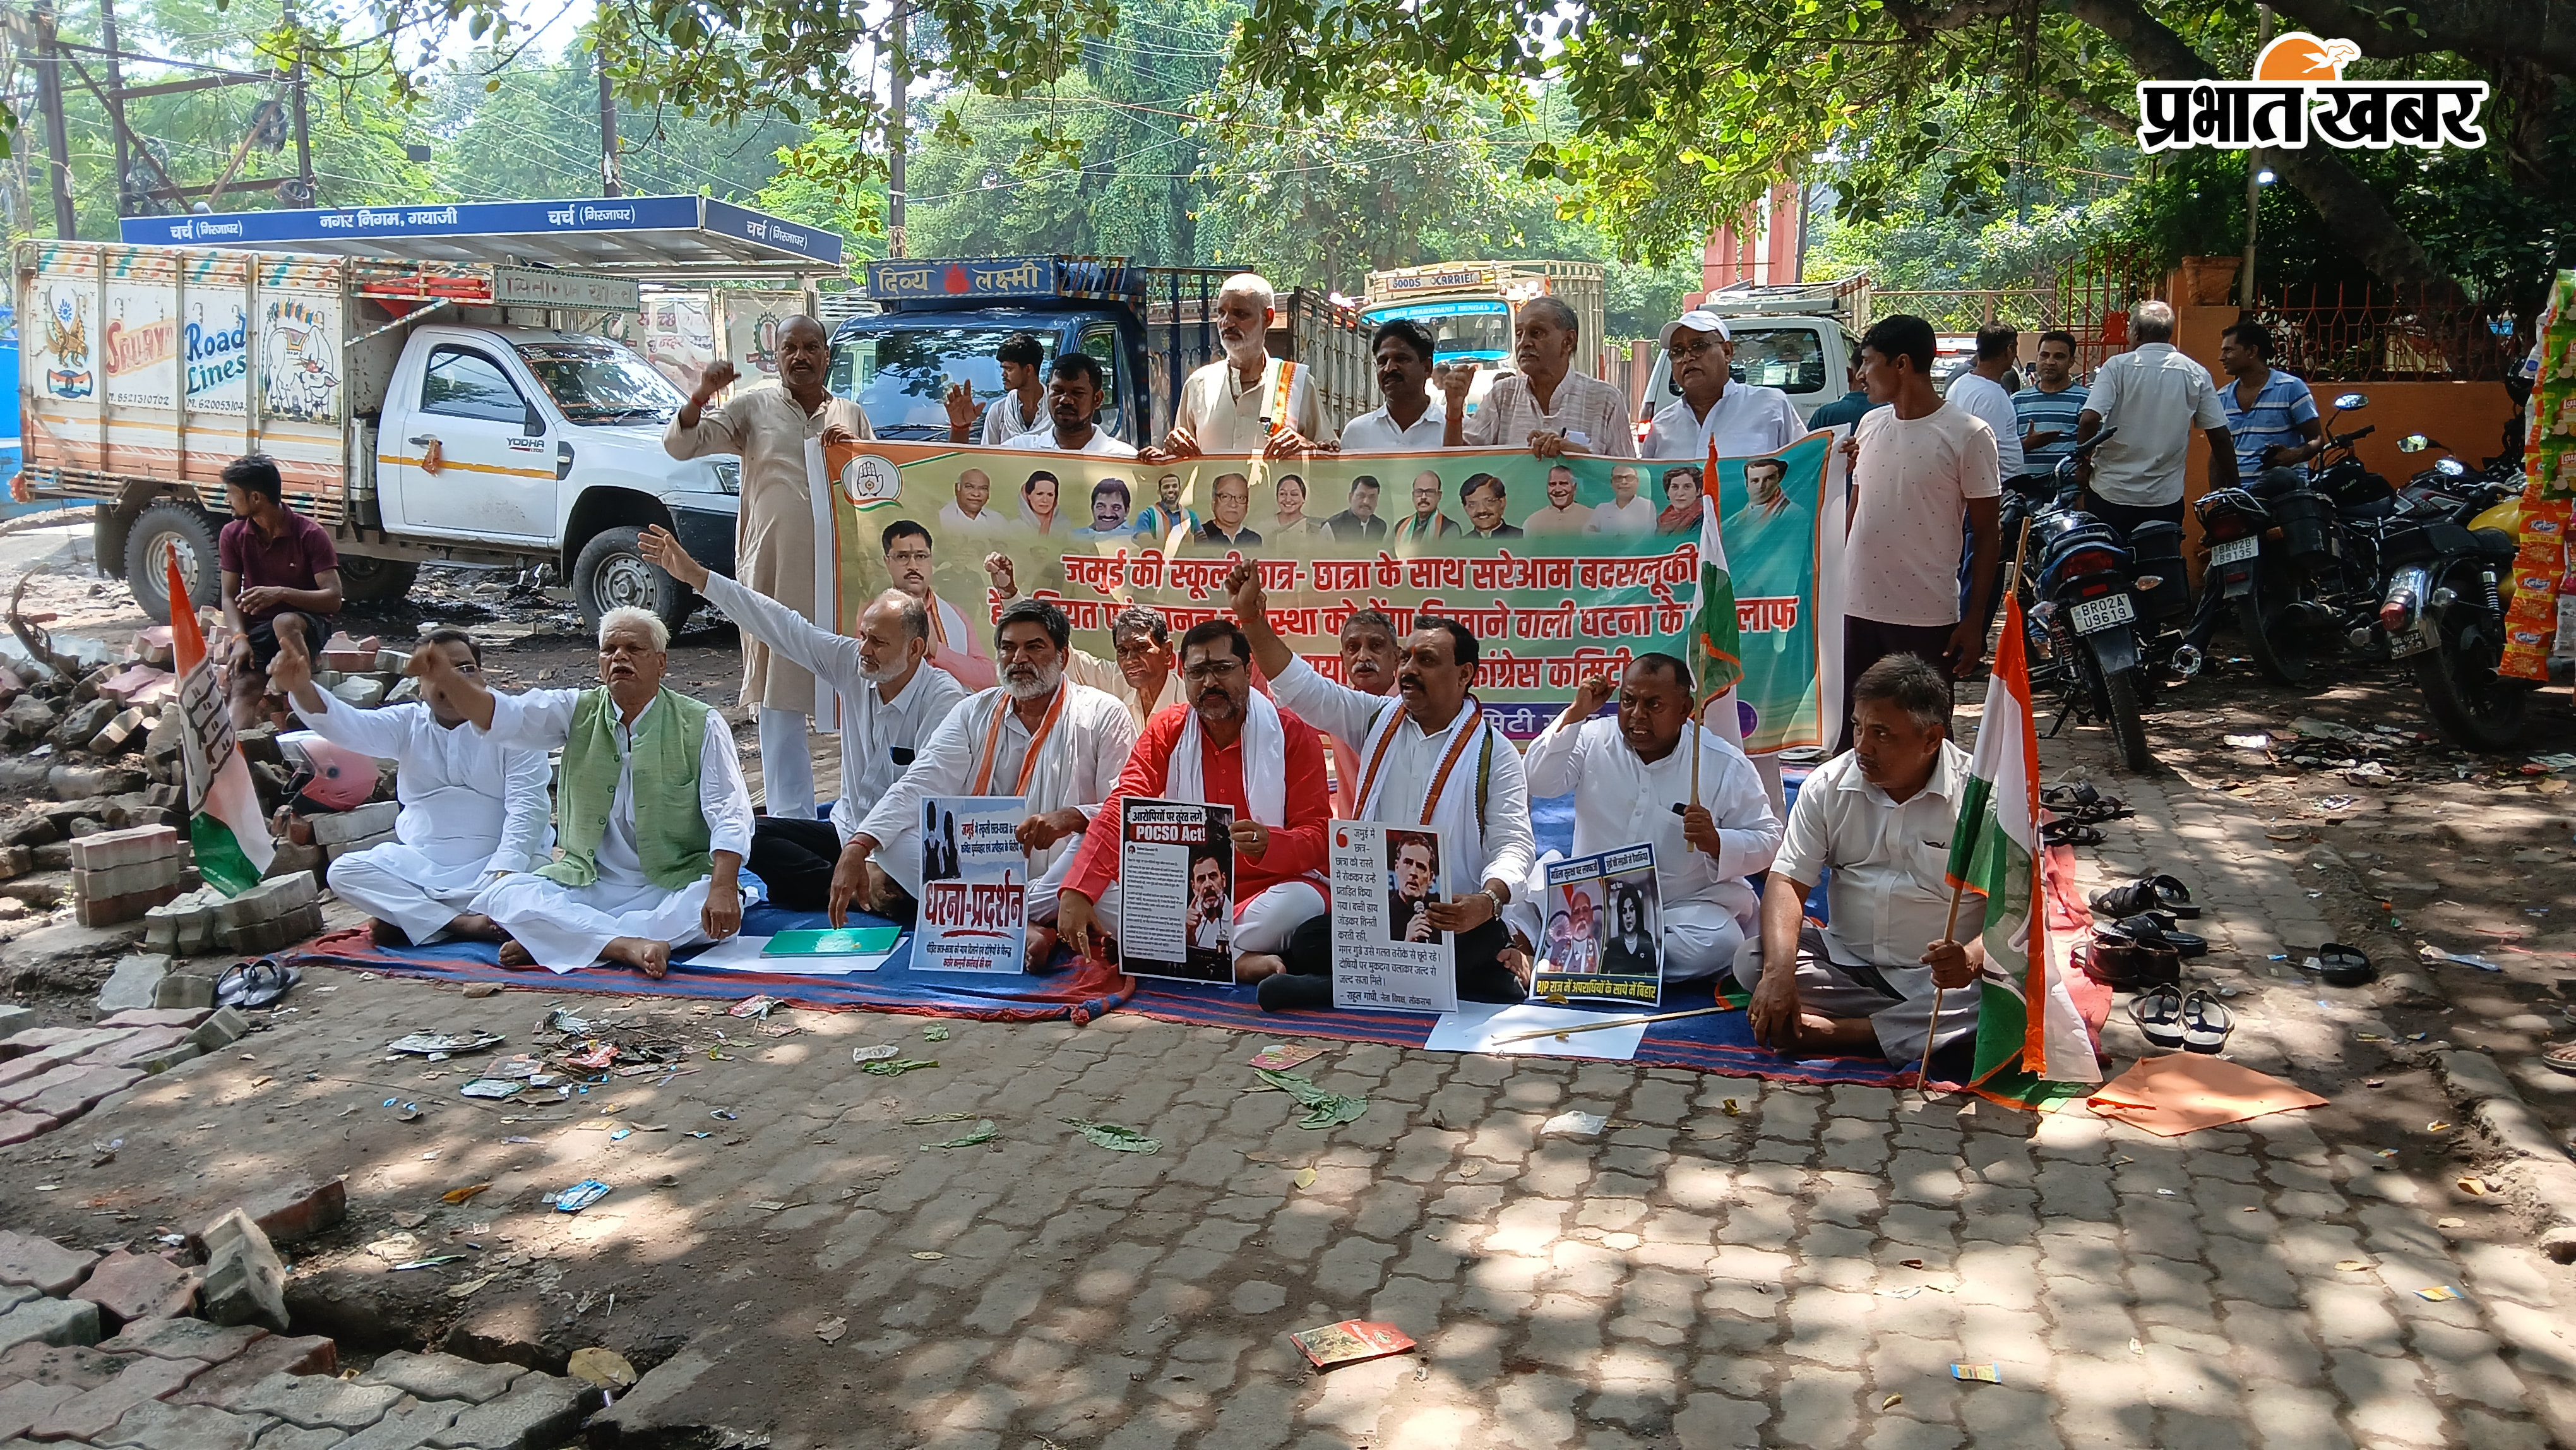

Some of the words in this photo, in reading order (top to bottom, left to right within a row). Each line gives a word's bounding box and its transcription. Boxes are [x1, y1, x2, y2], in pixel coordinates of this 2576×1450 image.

[320, 214, 353, 229] नगर
[357, 210, 405, 227] निगम,
[408, 207, 458, 224] गयाजी
[547, 204, 575, 225] चर्च
[580, 205, 635, 225] (गिरजाघर)
[170, 220, 193, 239] चर्च
[197, 224, 242, 239] (गिरजाघर)
[747, 219, 767, 239] चर्च
[769, 224, 808, 250] (गिरजाघर)
[876, 267, 936, 295] दिव्य
[972, 261, 1044, 291] लक्ष्मी
[1393, 278, 1421, 288] GOODS
[185, 312, 246, 360] Road
[186, 355, 246, 395] Lines
[506, 437, 545, 448] YODHA
[1061, 549, 1126, 594] जमुई
[1131, 549, 1165, 587] की
[1312, 561, 1370, 590] छात्रा
[1377, 551, 1402, 588] के
[1410, 558, 1466, 588] साथ
[1473, 549, 1576, 589] सरेआम
[1580, 544, 1698, 596] बदसलूकी
[2082, 596, 2125, 616] BR02A
[1516, 600, 1576, 638] वाली
[1580, 605, 1651, 637] घटना
[1657, 596, 1686, 633] के
[2084, 608, 2126, 628] U9619
[1132, 809, 1165, 822] आरोपियों
[1166, 812, 1174, 822] पर
[1176, 810, 1189, 824] तुरंत
[1190, 810, 1203, 822] लगे
[1136, 825, 1178, 841] POCSO
[1181, 826, 1206, 842] Act!
[1354, 827, 1368, 841] जमुई
[1349, 856, 1357, 867] को
[1359, 856, 1373, 868] रास्ते
[1342, 870, 1363, 882] रोककर
[925, 869, 1024, 929] धरना-प्रदर्शन
[1357, 885, 1373, 897] किया
[1337, 928, 1354, 940] करती
[1363, 945, 1374, 956] उसे
[1376, 948, 1390, 957] गलत
[1392, 947, 1408, 958] तरीके
[1409, 948, 1416, 959] से
[1338, 957, 1357, 969] दोषियों
[1359, 961, 1368, 970] पर
[1414, 966, 1428, 975] जल्द
[1339, 974, 1354, 984] जल्द
[1536, 980, 1549, 995] BJP
[1550, 981, 1563, 993] राज
[1563, 978, 1572, 993] में
[1571, 978, 1604, 994] अपराधियों
[1605, 980, 1613, 993] के
[1613, 981, 1628, 996] साये
[1629, 981, 1638, 997] में
[1637, 980, 1656, 998] बिहार
[1346, 991, 1361, 1003] राहुल
